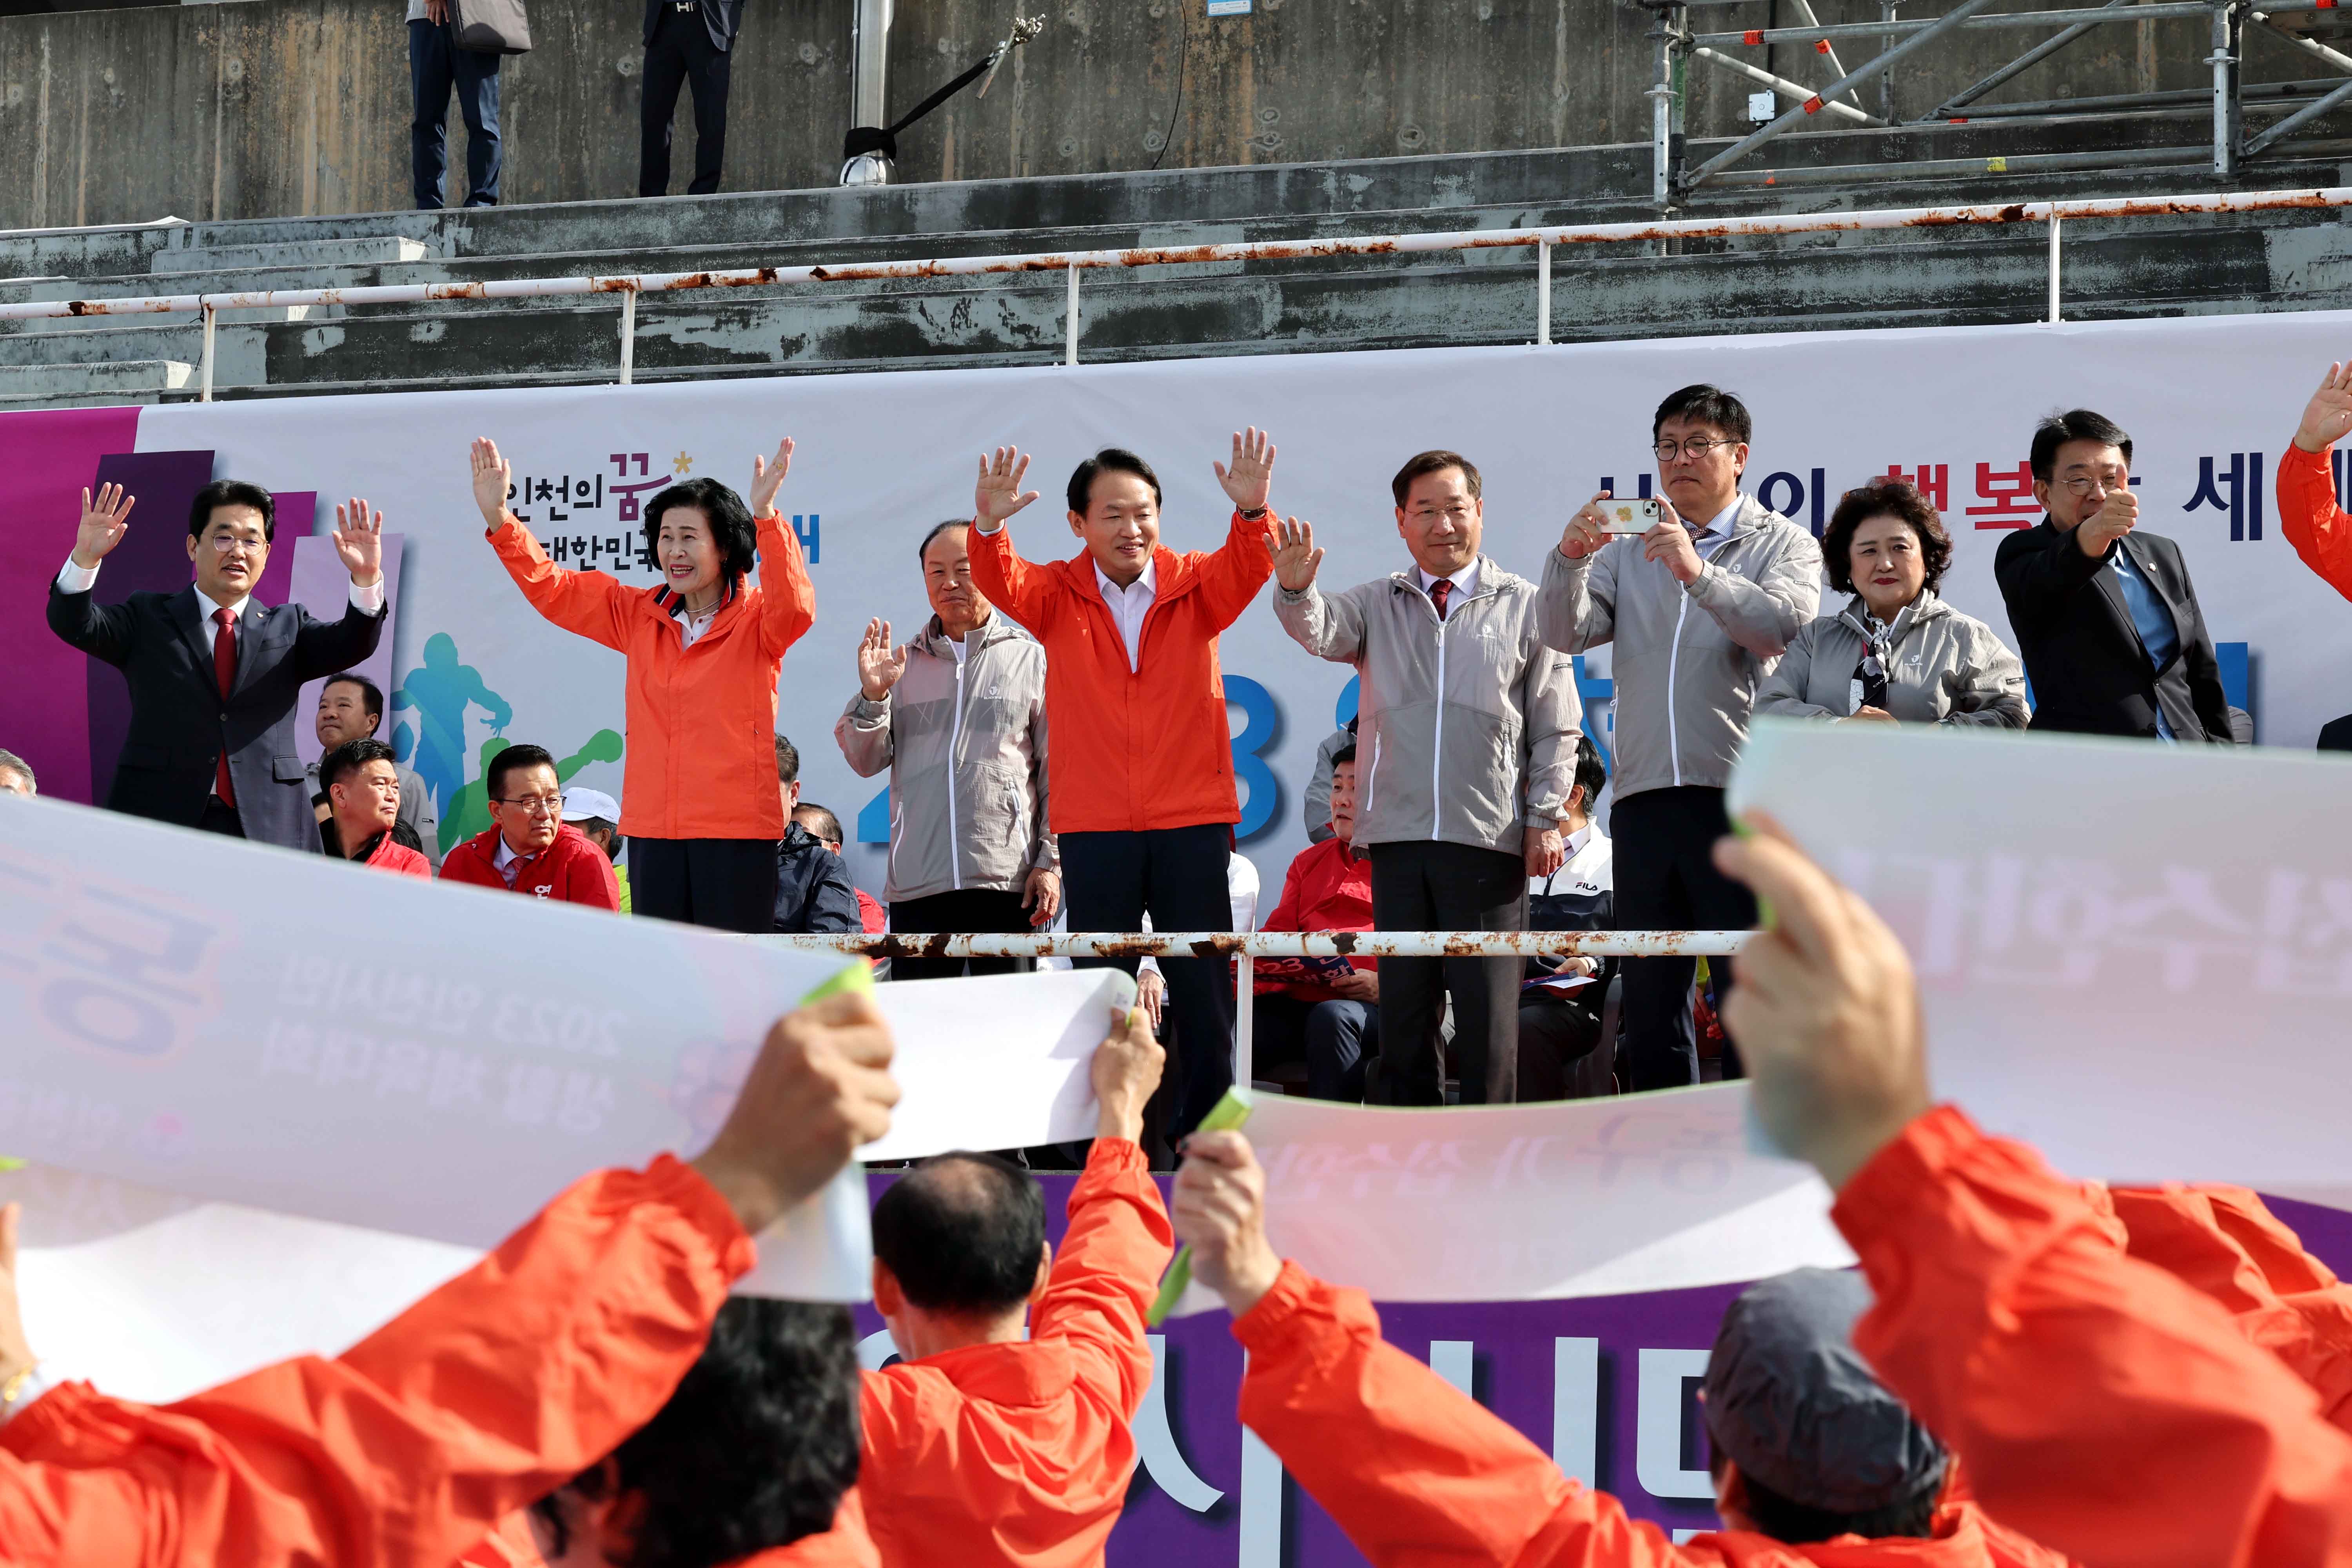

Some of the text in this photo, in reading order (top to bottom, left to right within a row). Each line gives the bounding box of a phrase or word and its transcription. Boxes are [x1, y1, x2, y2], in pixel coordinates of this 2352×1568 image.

[508, 453, 673, 522] 인천의 꿈
[1575, 882, 1598, 891] FILA
